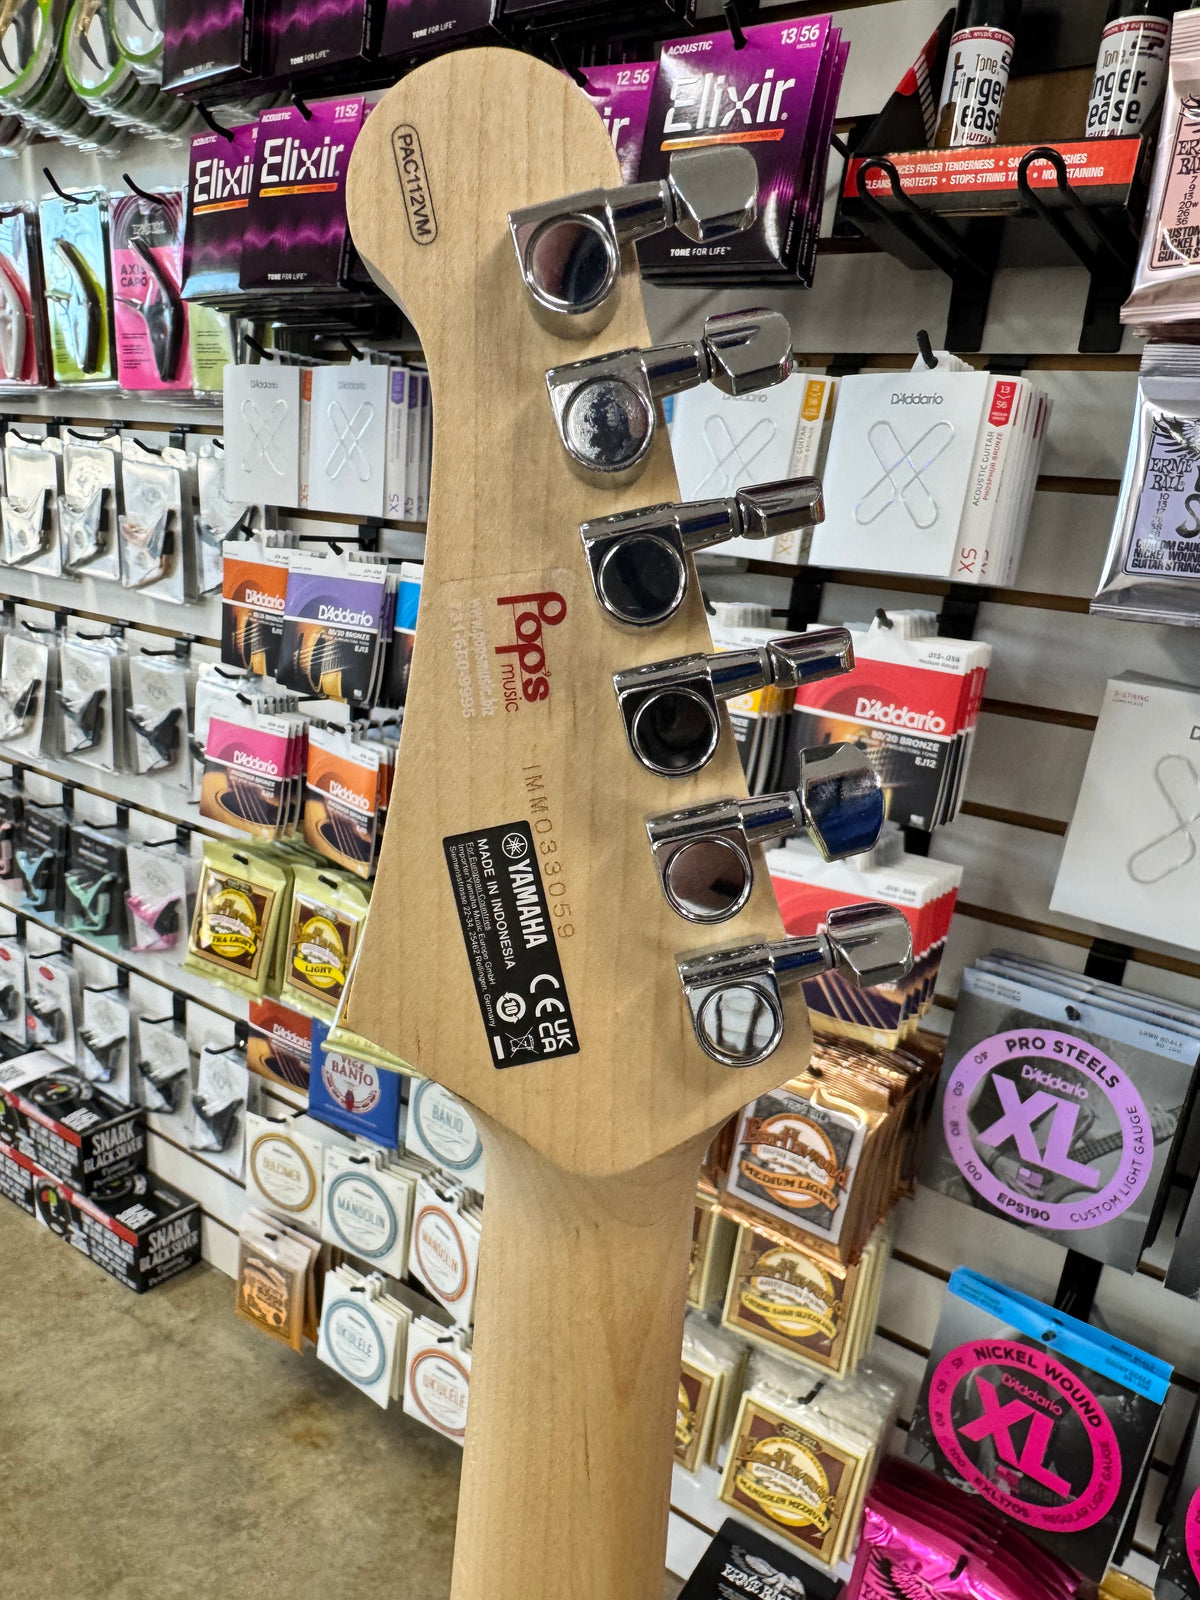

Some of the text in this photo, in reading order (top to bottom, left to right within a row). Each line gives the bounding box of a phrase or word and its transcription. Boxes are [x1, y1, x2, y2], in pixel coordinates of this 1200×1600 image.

[428, 24, 440, 34] FOR
[781, 24, 820, 44] 13 56
[304, 54, 314, 62] FOR
[668, 41, 712, 55] ACOUSTIC
[616, 69, 650, 85] 12 56
[664, 69, 796, 133] Elixir
[1088, 100, 1140, 128] ease
[261, 136, 344, 184] Elixir
[916, 162, 942, 173] FINGER
[945, 160, 994, 171] TENDERNESS
[398, 133, 431, 236] PAC112VM
[900, 177, 938, 187] PROTECTS
[950, 174, 975, 185] STOPS
[976, 172, 1005, 183] STRING
[1176, 218, 1188, 226] 36
[1177, 210, 1190, 218] 26
[670, 248, 690, 256] TONE
[692, 248, 707, 256] FOR
[120, 276, 148, 288] CAPO
[891, 392, 944, 405] D'Addario
[972, 431, 995, 507] ACOUSTIC GUITAR
[1149, 458, 1194, 474] ERNIE
[1150, 474, 1184, 492] BALL
[958, 547, 977, 574] XS
[246, 588, 286, 610] D'Addario
[318, 605, 373, 626] D'Addario
[501, 664, 523, 713] music
[855, 697, 946, 733] D'Addario
[900, 736, 940, 752] BRONZE
[234, 750, 278, 774] D'Addario
[522, 764, 575, 939] IMM033059
[464, 842, 474, 856] For
[476, 893, 492, 930] Countries
[475, 838, 517, 969] MADE IN INDONESIA
[505, 859, 550, 949] YAMAHA
[471, 909, 483, 932] Music
[483, 961, 495, 985] GmbH
[305, 964, 332, 974] LIGHT
[481, 993, 496, 1027] Germany
[331, 1060, 374, 1087] BANJO
[1006, 1036, 1120, 1089] PRO STEELS
[1020, 1064, 1089, 1100] D'Addario
[92, 1119, 135, 1156] SNARK
[976, 1072, 1100, 1188] XL
[1070, 1104, 1145, 1224] CUSTOM LIGHT GAUGE
[996, 1192, 1050, 1222] EPS190
[149, 1215, 192, 1254] SNARK
[974, 1346, 1038, 1369] NICKEL
[1045, 1362, 1102, 1428] WOUND
[1001, 1372, 1063, 1416] D'Addario
[958, 1374, 1072, 1499] XL
